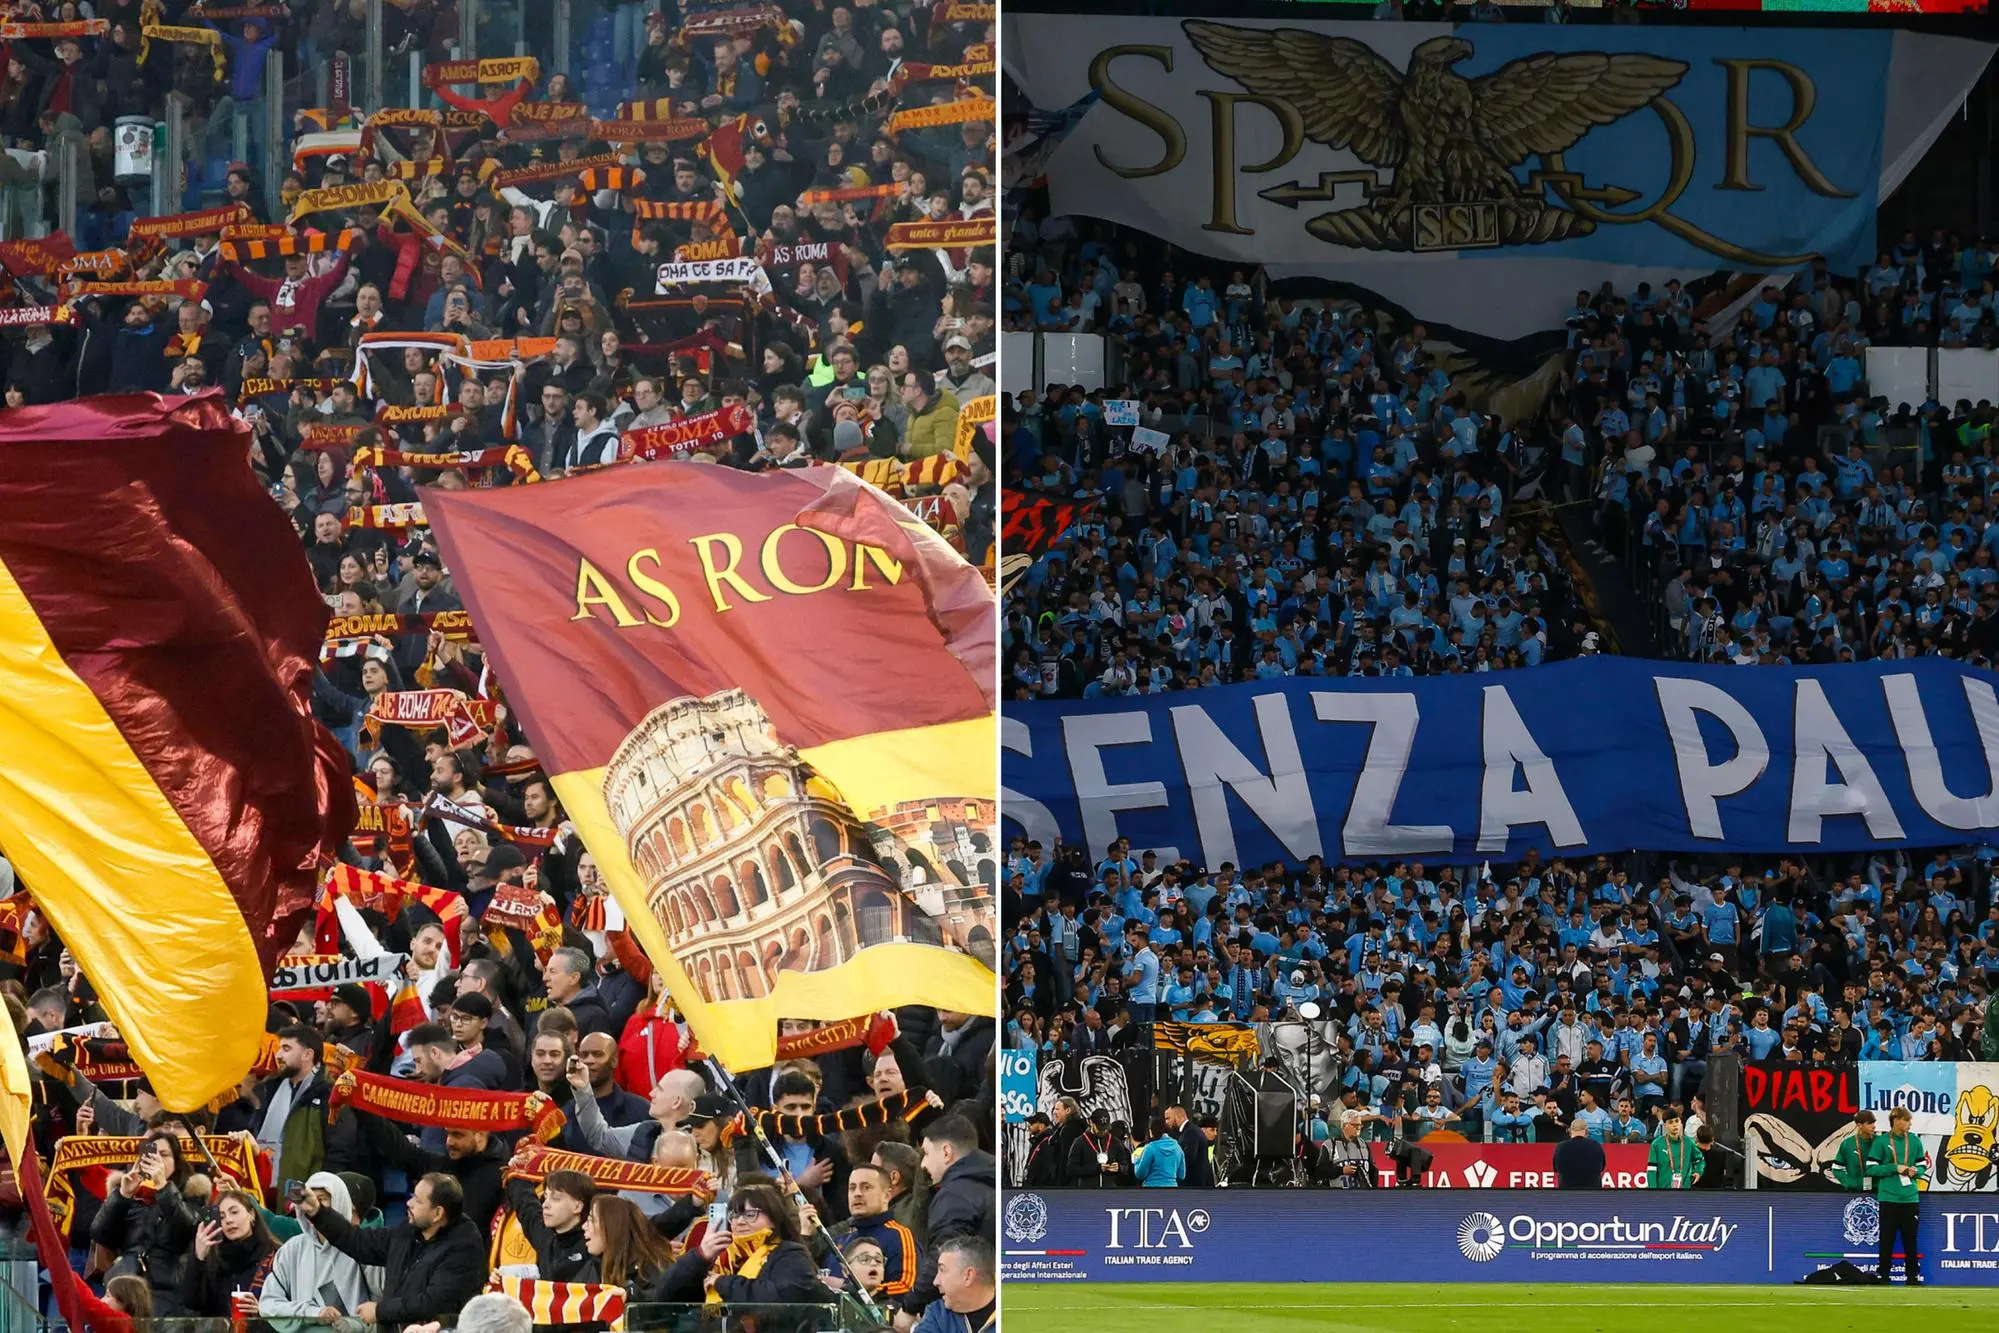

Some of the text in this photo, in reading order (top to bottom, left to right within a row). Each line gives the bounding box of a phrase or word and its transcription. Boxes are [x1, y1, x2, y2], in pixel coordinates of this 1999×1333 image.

[943, 222, 986, 241] grande
[794, 242, 828, 261] ROMA
[660, 264, 688, 279] OMA
[643, 418, 722, 449] ROMA
[645, 431, 724, 457] 10 TOTTI 10
[569, 522, 904, 629] AS ROM
[326, 612, 399, 641] SROMA
[433, 610, 474, 628] ASR
[397, 693, 431, 719] ROMA
[99, 1063, 127, 1075] Ultrà
[362, 1082, 520, 1121] CAMMINERÒ INSIEME A TE
[1864, 1081, 1951, 1115] Lucone
[537, 1152, 693, 1185] ROMA HA VINTO
[1104, 1208, 1194, 1248] ITA
[1508, 1215, 1738, 1251] OpportunItaly
[1940, 1213, 1999, 1252] IT
[1012, 1261, 1031, 1271] degli
[1032, 1261, 1052, 1269] Affari
[1052, 1261, 1074, 1269] Esteri
[1104, 1256, 1194, 1265] ITALIAN TRADE AGENCY
[1536, 1252, 1579, 1261] programma
[1587, 1251, 1643, 1259] accelerazione
[1941, 1260, 1997, 1269] ITALIAN TRADE
